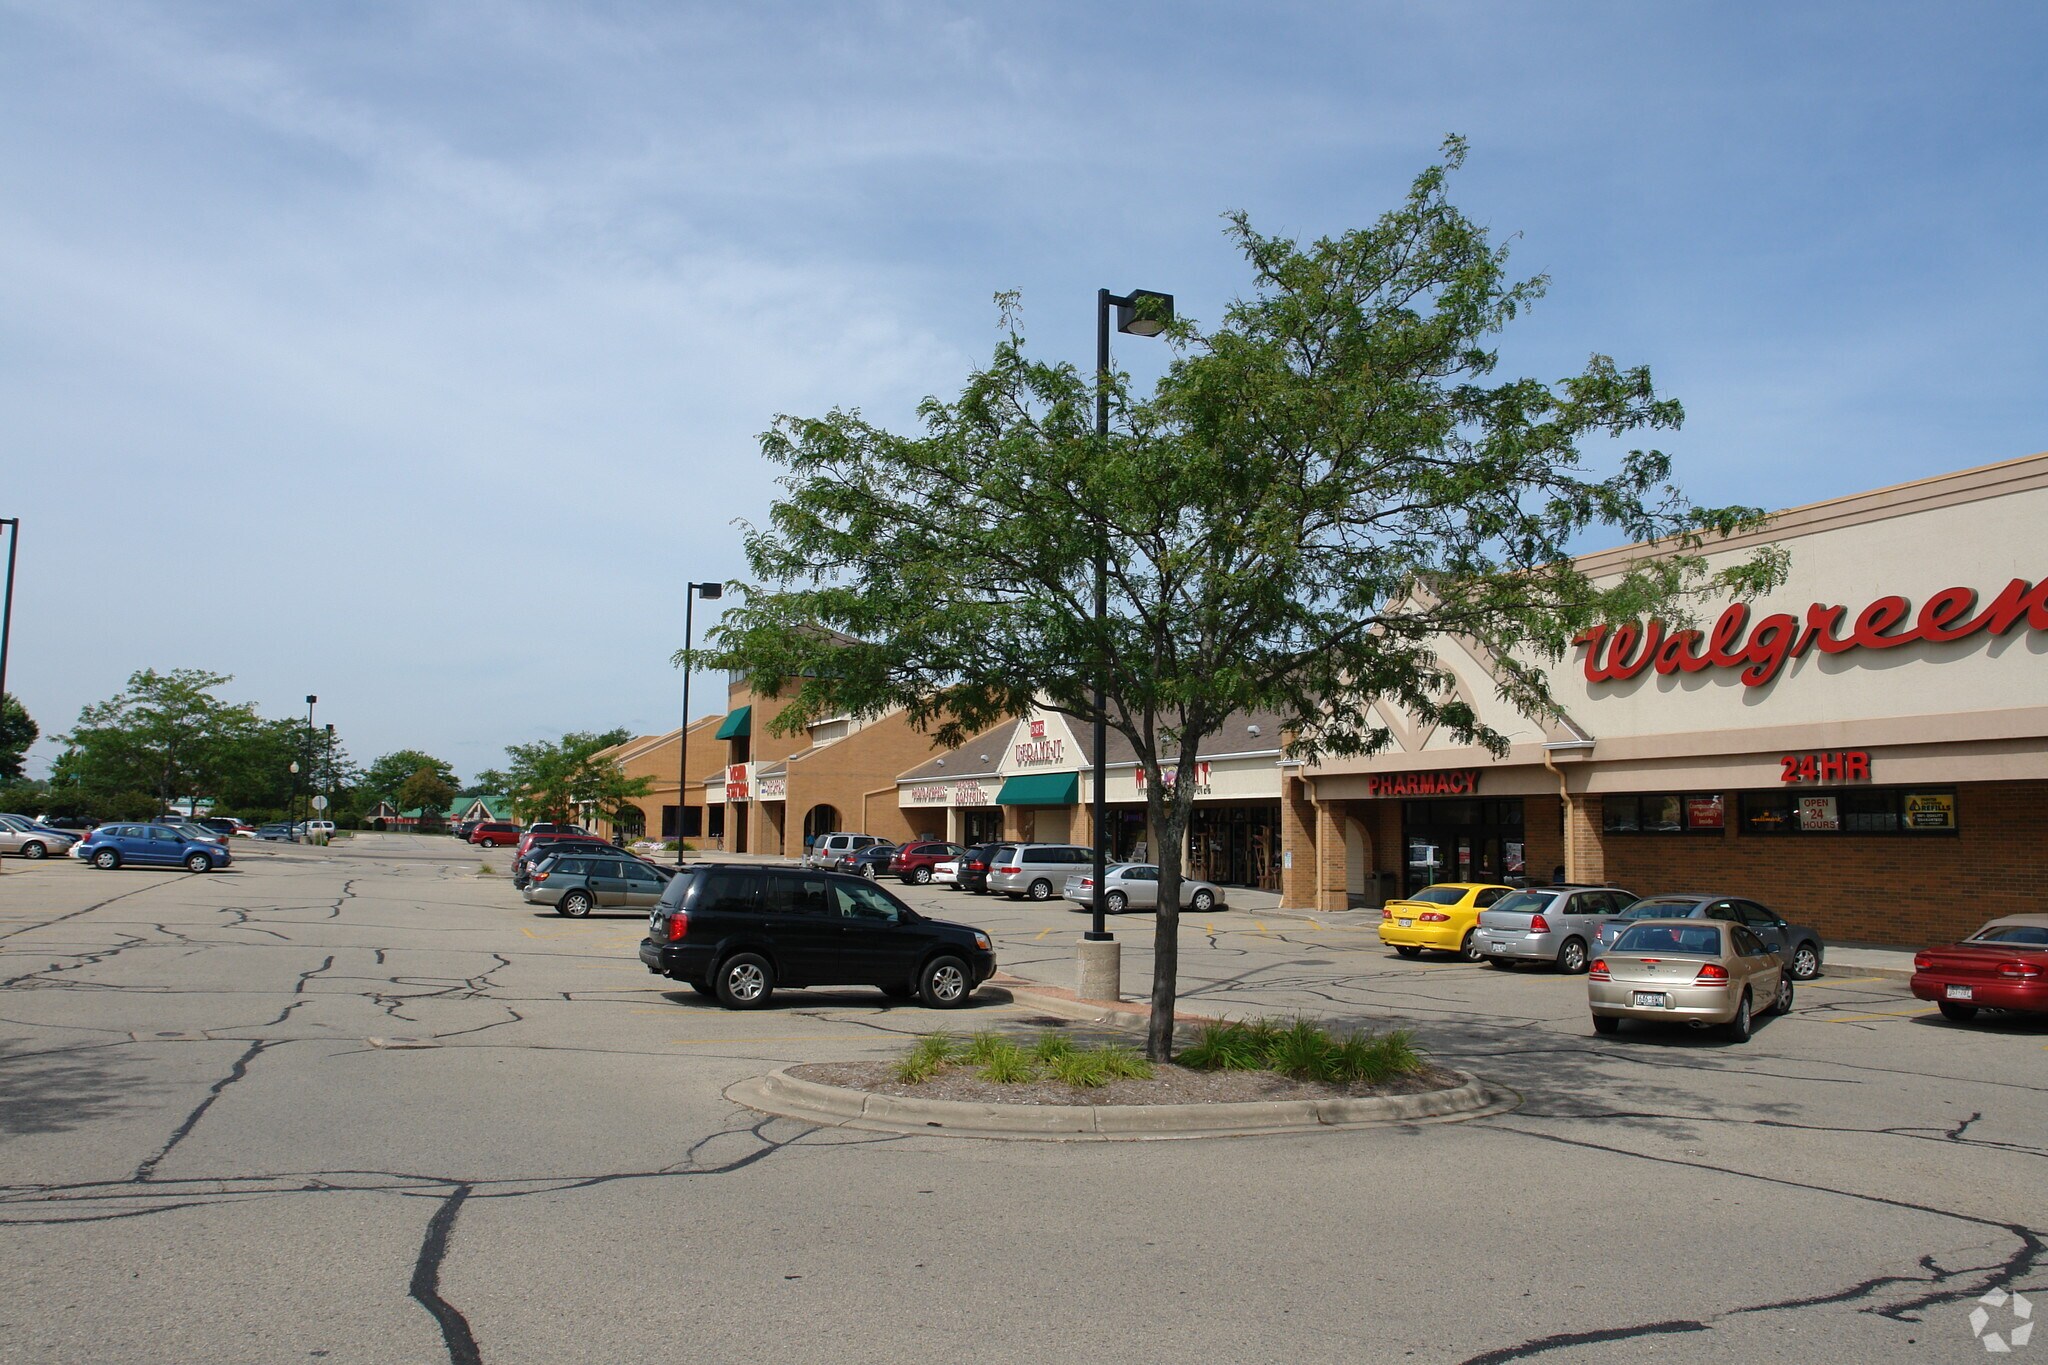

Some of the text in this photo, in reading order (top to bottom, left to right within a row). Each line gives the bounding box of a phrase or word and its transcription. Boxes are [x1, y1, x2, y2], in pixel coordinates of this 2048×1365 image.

[1572, 576, 2048, 688] Walgreen
[1368, 771, 1477, 796] PHARMACY
[1804, 799, 1828, 807] OPEN
[1810, 809, 1824, 819] 24
[1803, 821, 1836, 829] HOURS
